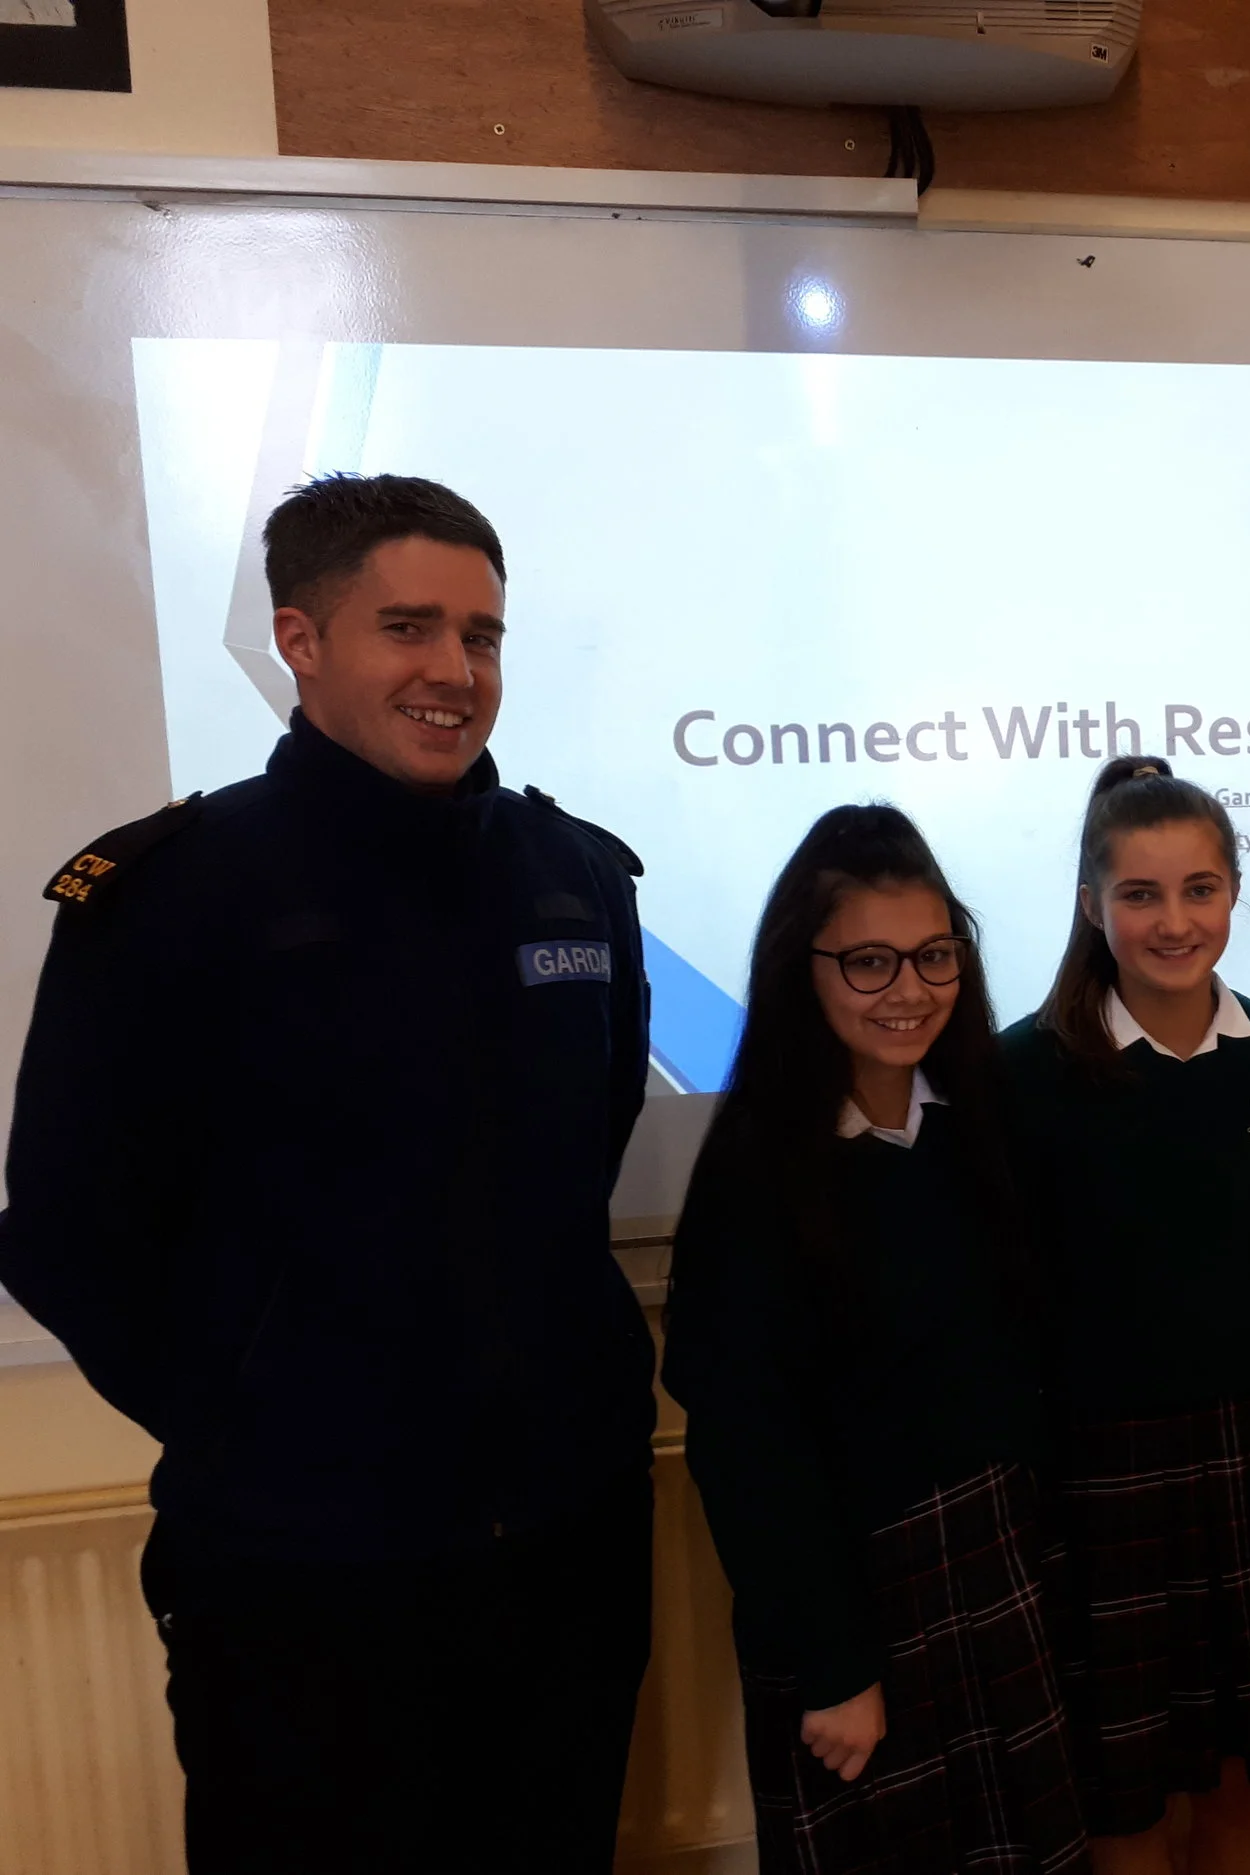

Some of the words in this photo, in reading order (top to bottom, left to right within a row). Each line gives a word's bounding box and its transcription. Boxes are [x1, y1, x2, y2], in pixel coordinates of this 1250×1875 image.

[1091, 45, 1107, 61] 3M
[673, 709, 969, 767] Connect
[981, 701, 1141, 760] With
[72, 854, 117, 877] CW
[52, 874, 93, 902] 284
[533, 947, 611, 976] GARDA
